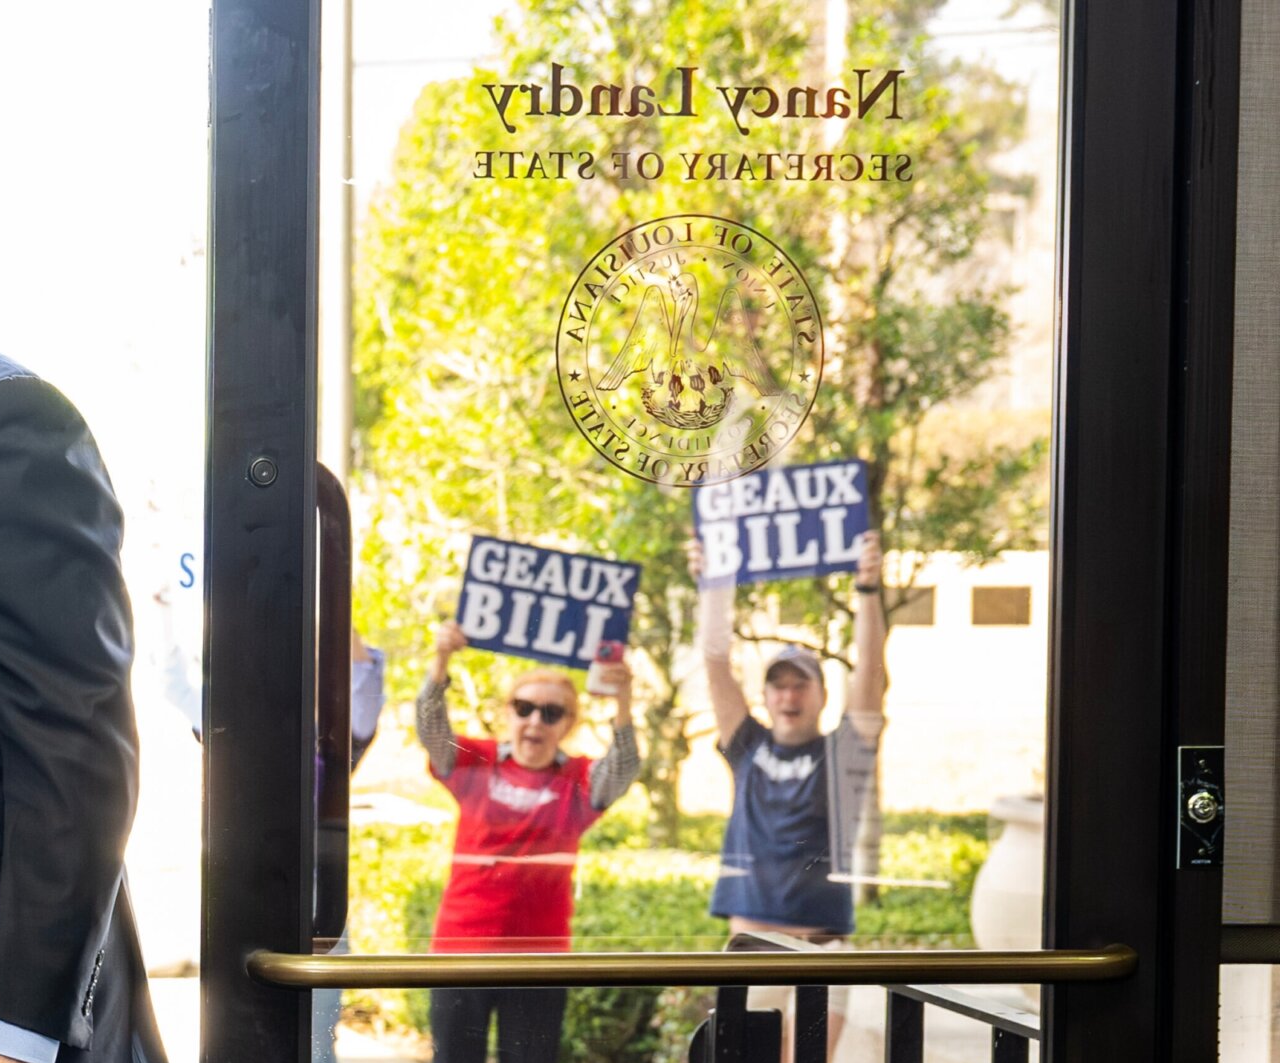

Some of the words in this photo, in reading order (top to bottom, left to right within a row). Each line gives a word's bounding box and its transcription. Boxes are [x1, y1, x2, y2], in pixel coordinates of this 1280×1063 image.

[696, 464, 862, 521] GEAUX
[470, 540, 634, 607] GEAUX
[699, 507, 865, 580] BILL
